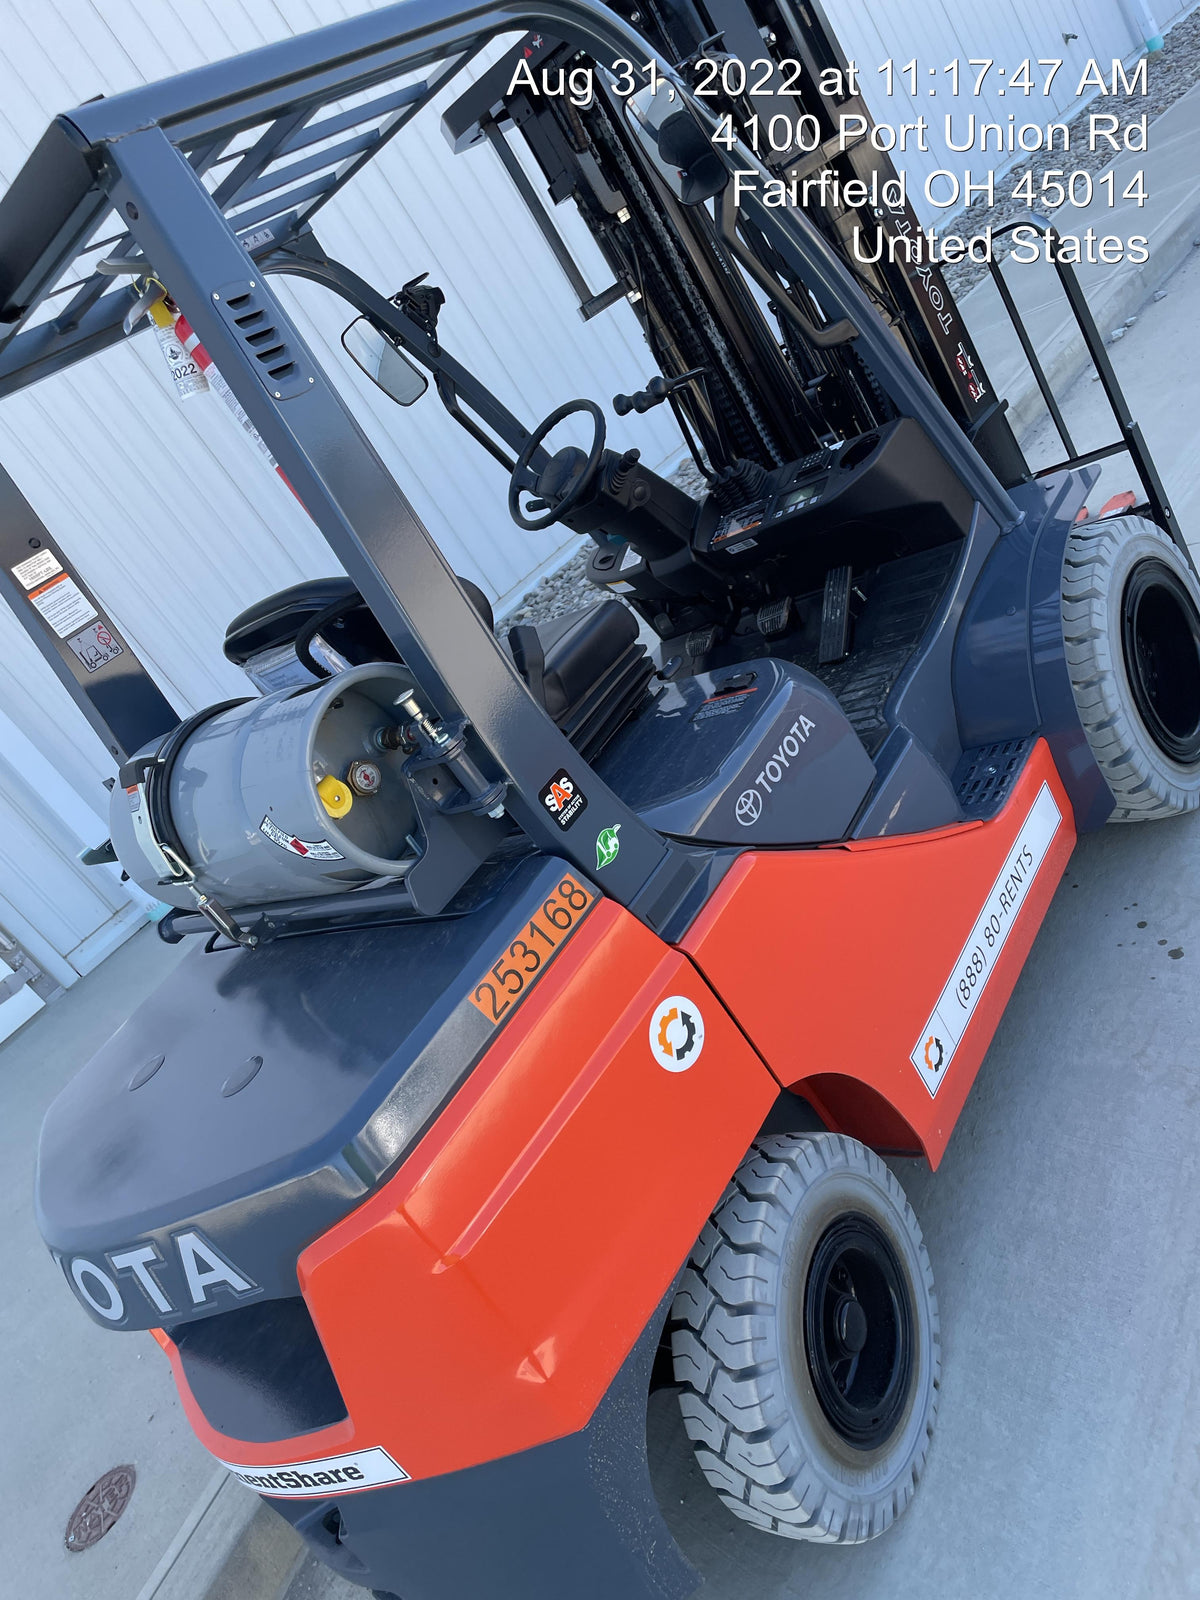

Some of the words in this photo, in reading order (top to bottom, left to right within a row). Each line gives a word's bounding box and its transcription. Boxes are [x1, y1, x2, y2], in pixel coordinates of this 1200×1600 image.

[544, 777, 574, 812] SAS
[755, 714, 816, 793] TOYOTA
[560, 797, 583, 825] STABILITY
[474, 879, 588, 1021] 253168
[955, 945, 988, 1009] (888)
[983, 844, 1034, 948] 80-RENTS
[55, 1231, 252, 1321] OTA
